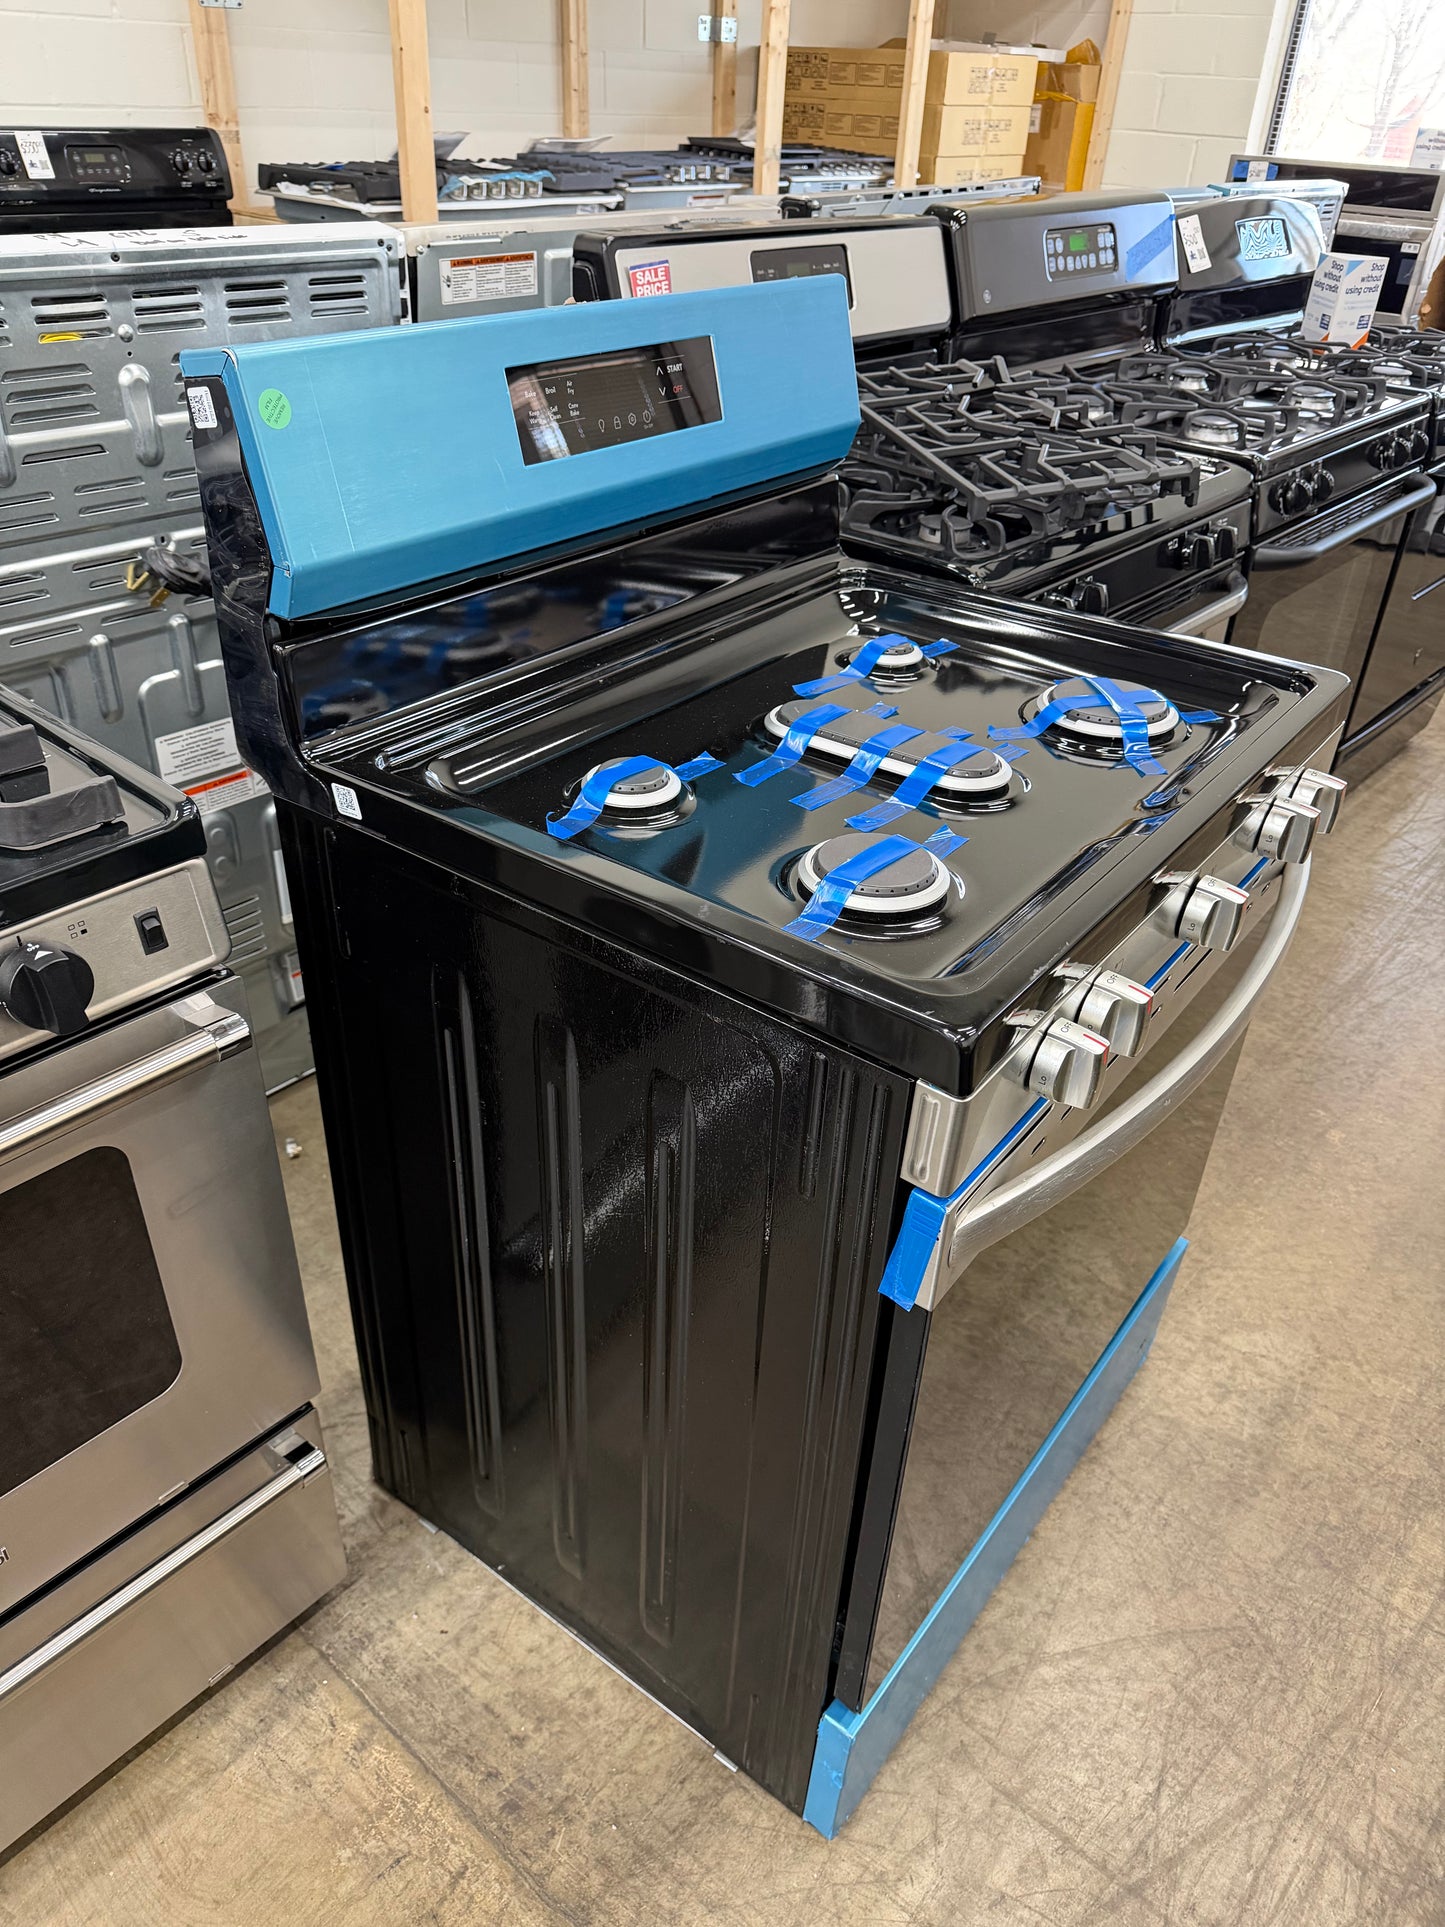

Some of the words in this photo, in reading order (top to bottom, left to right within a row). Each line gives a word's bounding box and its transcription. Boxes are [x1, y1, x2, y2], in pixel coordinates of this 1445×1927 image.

[1331, 260, 1344, 272] Shop
[1371, 262, 1385, 272] Shop
[636, 267, 667, 285] SALE
[1323, 270, 1342, 283] without
[1360, 274, 1383, 283] without
[636, 280, 670, 297] PRICE
[1325, 282, 1340, 294] credit
[1345, 285, 1362, 296] using
[1362, 284, 1380, 294] credit
[666, 363, 683, 373] START
[524, 390, 537, 398] Bake
[545, 386, 557, 395] Broil
[672, 384, 683, 393] OFF
[1187, 922, 1196, 932] Lo
[1106, 973, 1120, 985] OFF
[1060, 1022, 1074, 1034] OFF
[1038, 1075, 1047, 1086] Lo
